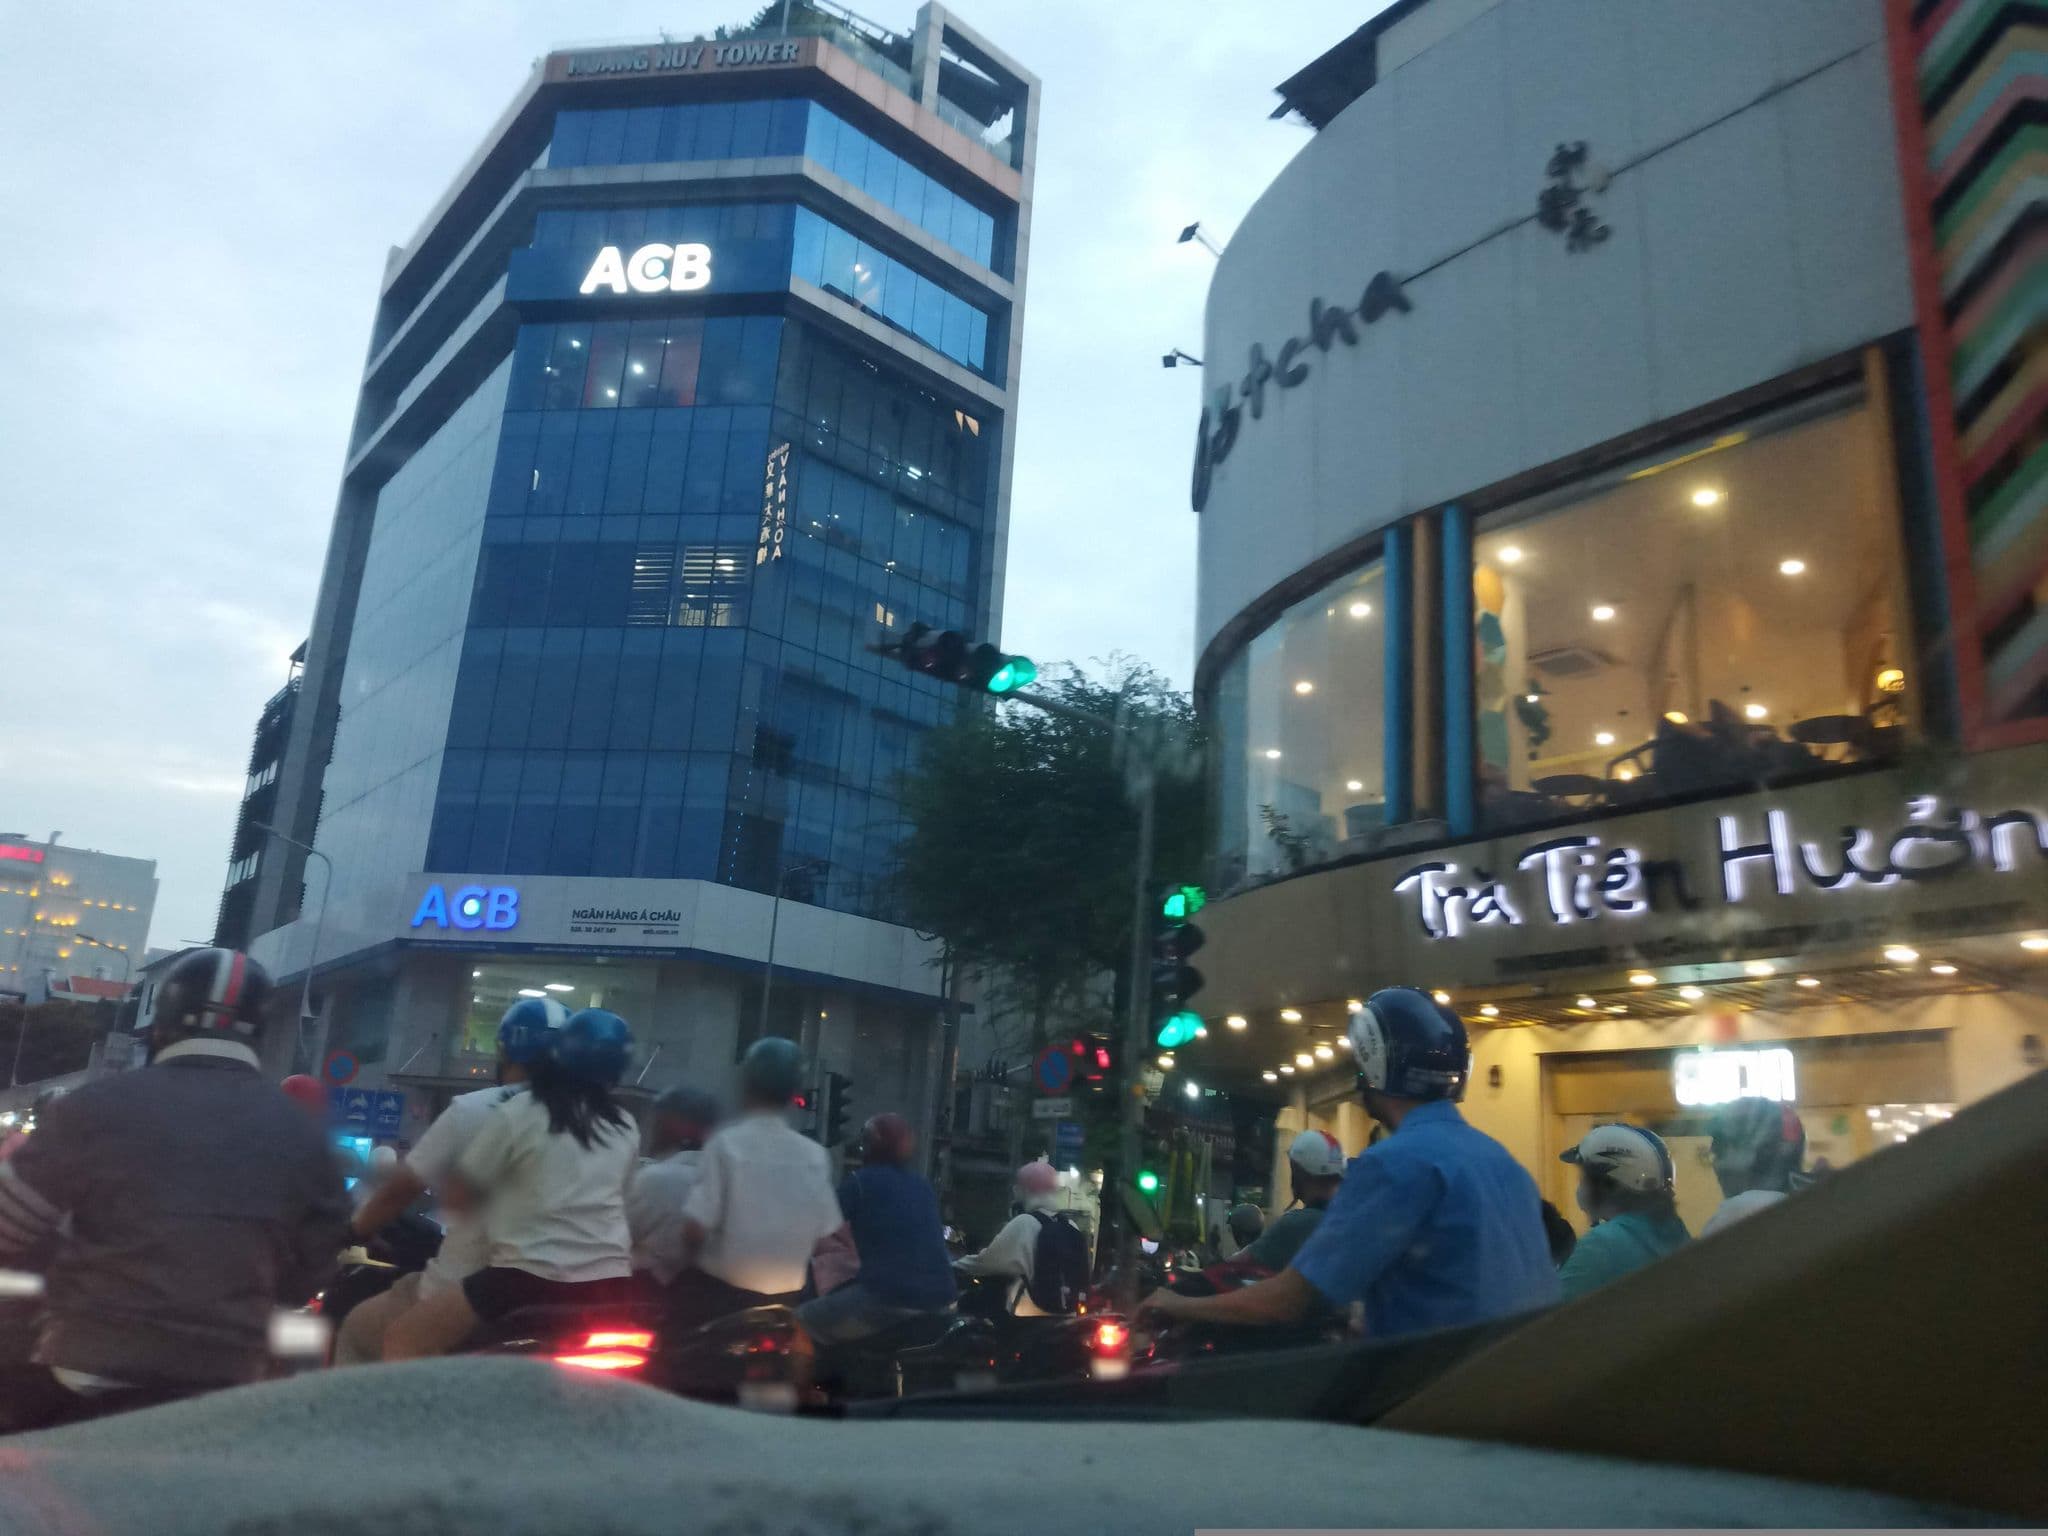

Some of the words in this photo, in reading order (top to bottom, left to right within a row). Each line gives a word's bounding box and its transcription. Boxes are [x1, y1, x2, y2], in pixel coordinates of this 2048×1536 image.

[656, 45, 704, 71] HUY
[715, 39, 800, 66] TOWER
[579, 243, 712, 294] ACB
[410, 883, 520, 931] ACB
[1392, 860, 1523, 940] Trà
[1517, 835, 1700, 923] Tiên
[572, 908, 604, 919] NGÂN
[605, 908, 638, 921] HÀNG
[640, 908, 648, 920] Á
[649, 909, 681, 921] CHÂU
